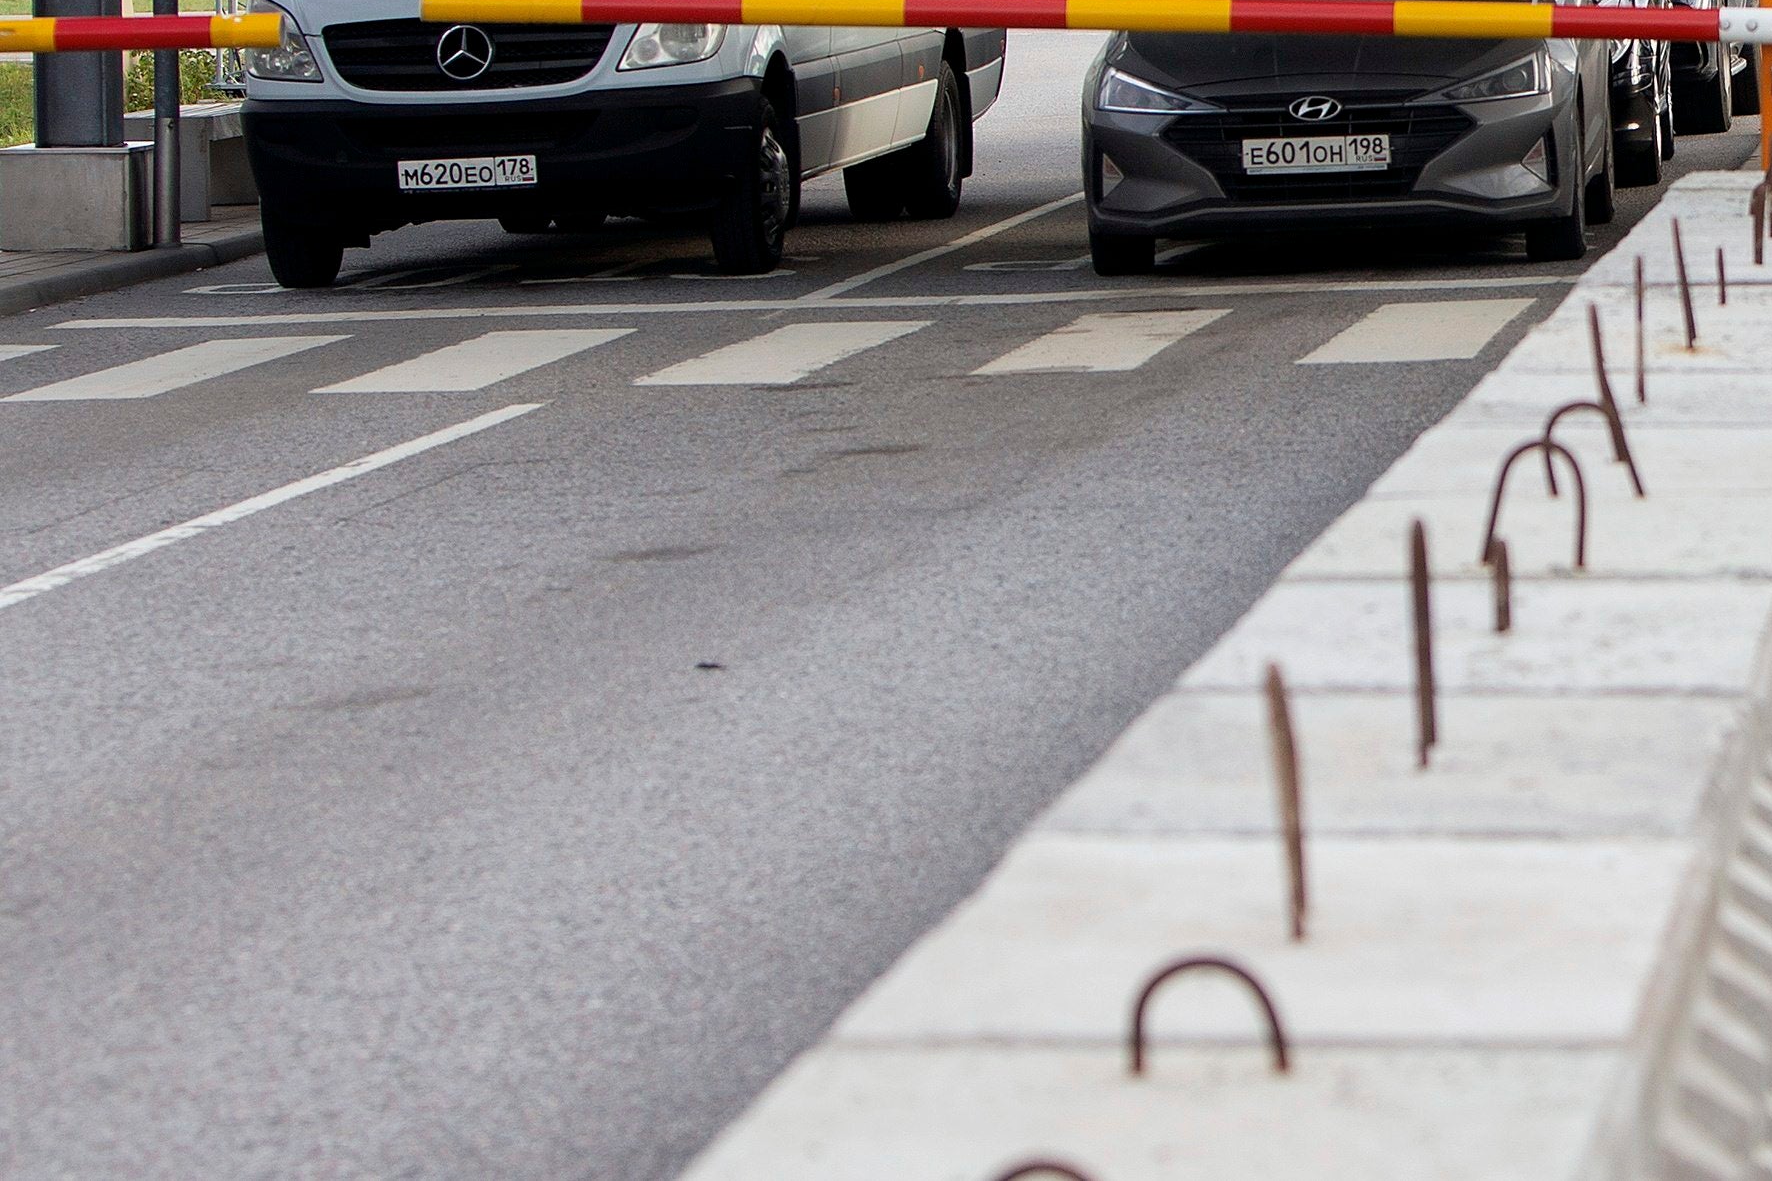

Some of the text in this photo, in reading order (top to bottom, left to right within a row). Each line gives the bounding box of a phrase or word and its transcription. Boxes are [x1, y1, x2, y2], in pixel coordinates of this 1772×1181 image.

[1348, 137, 1383, 155] 198
[1355, 155, 1373, 163] RUS
[496, 158, 530, 176] 178
[504, 175, 521, 183] RUS
